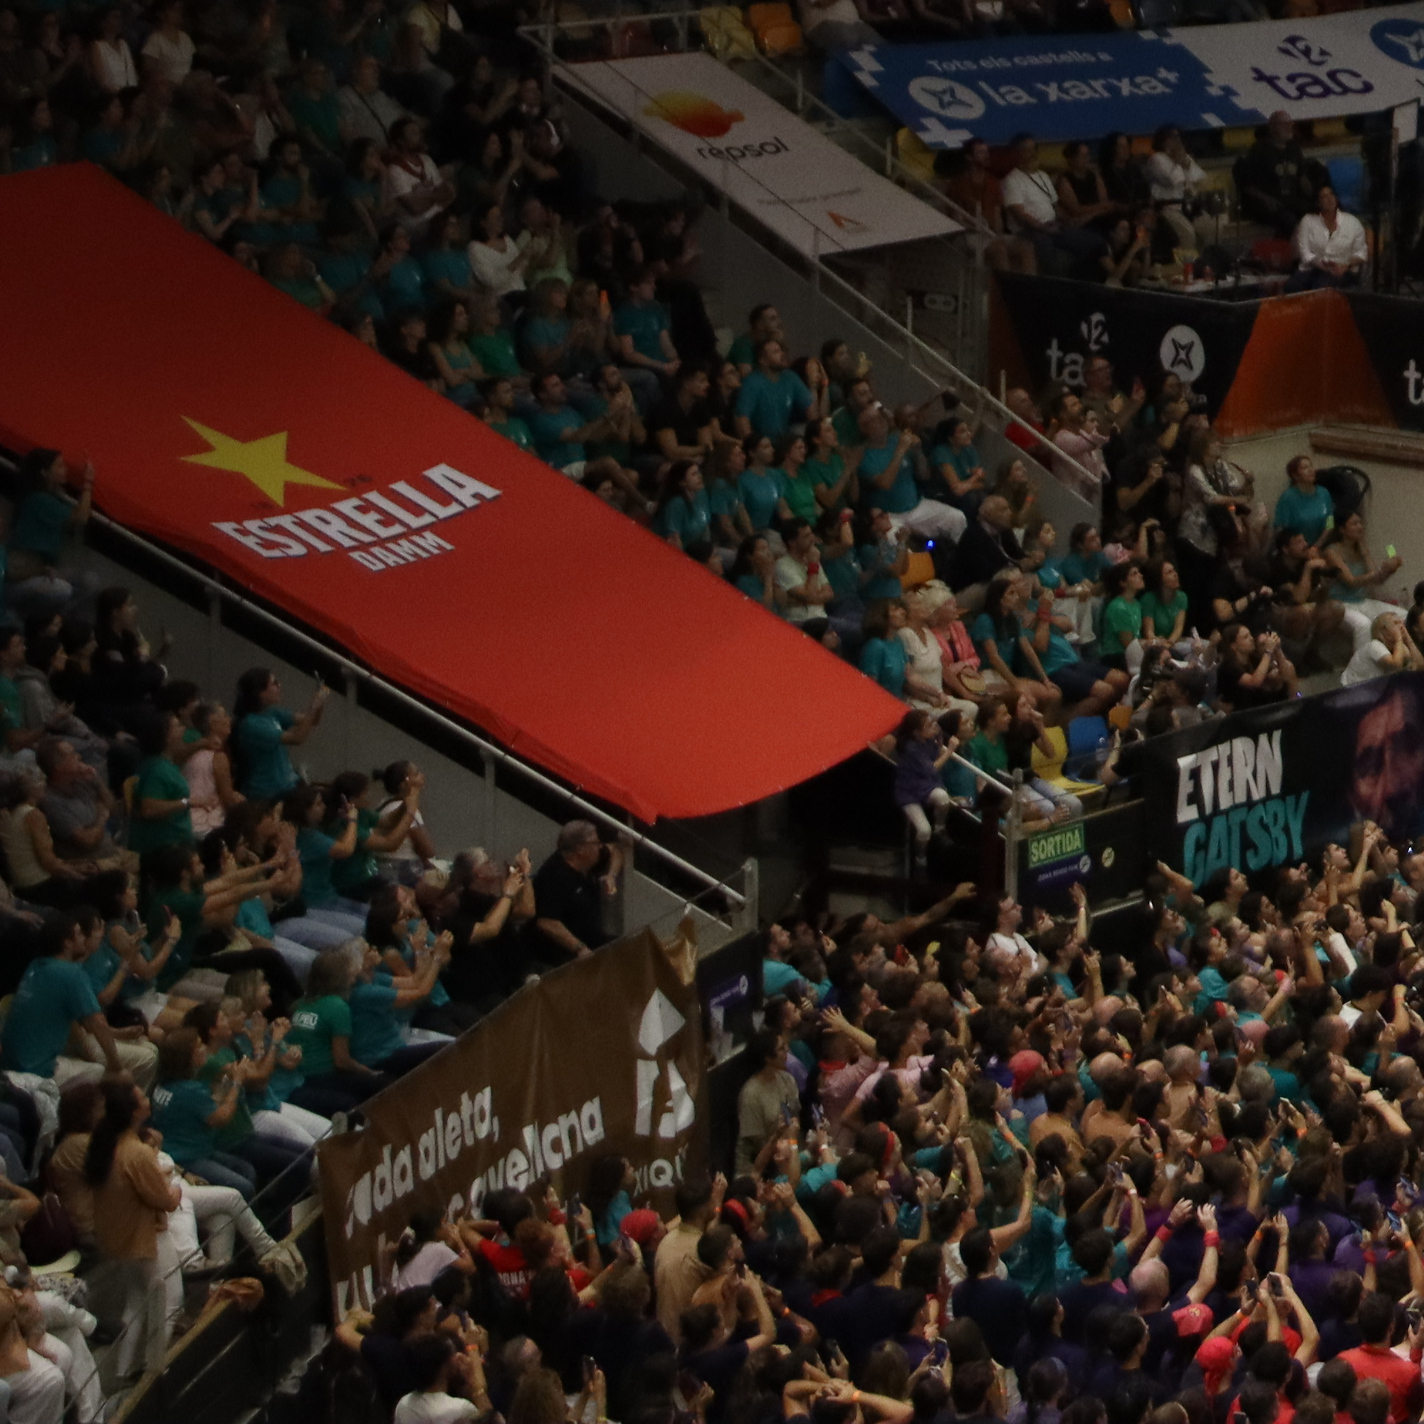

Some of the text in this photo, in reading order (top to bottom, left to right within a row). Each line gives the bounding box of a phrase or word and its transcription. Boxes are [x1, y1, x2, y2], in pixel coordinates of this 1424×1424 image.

[926, 51, 1113, 74] Tots els castells a
[1249, 63, 1374, 103] tac
[980, 79, 1037, 108] la
[696, 136, 789, 163] repsol
[1046, 337, 1087, 388] ta
[211, 462, 503, 559] ESTRELLA
[347, 530, 456, 572] DAMM
[1176, 728, 1283, 825] ETERN
[1030, 829, 1082, 863] SORTIDA
[1183, 788, 1311, 897] GATSBY
[418, 1084, 500, 1181] aleta,
